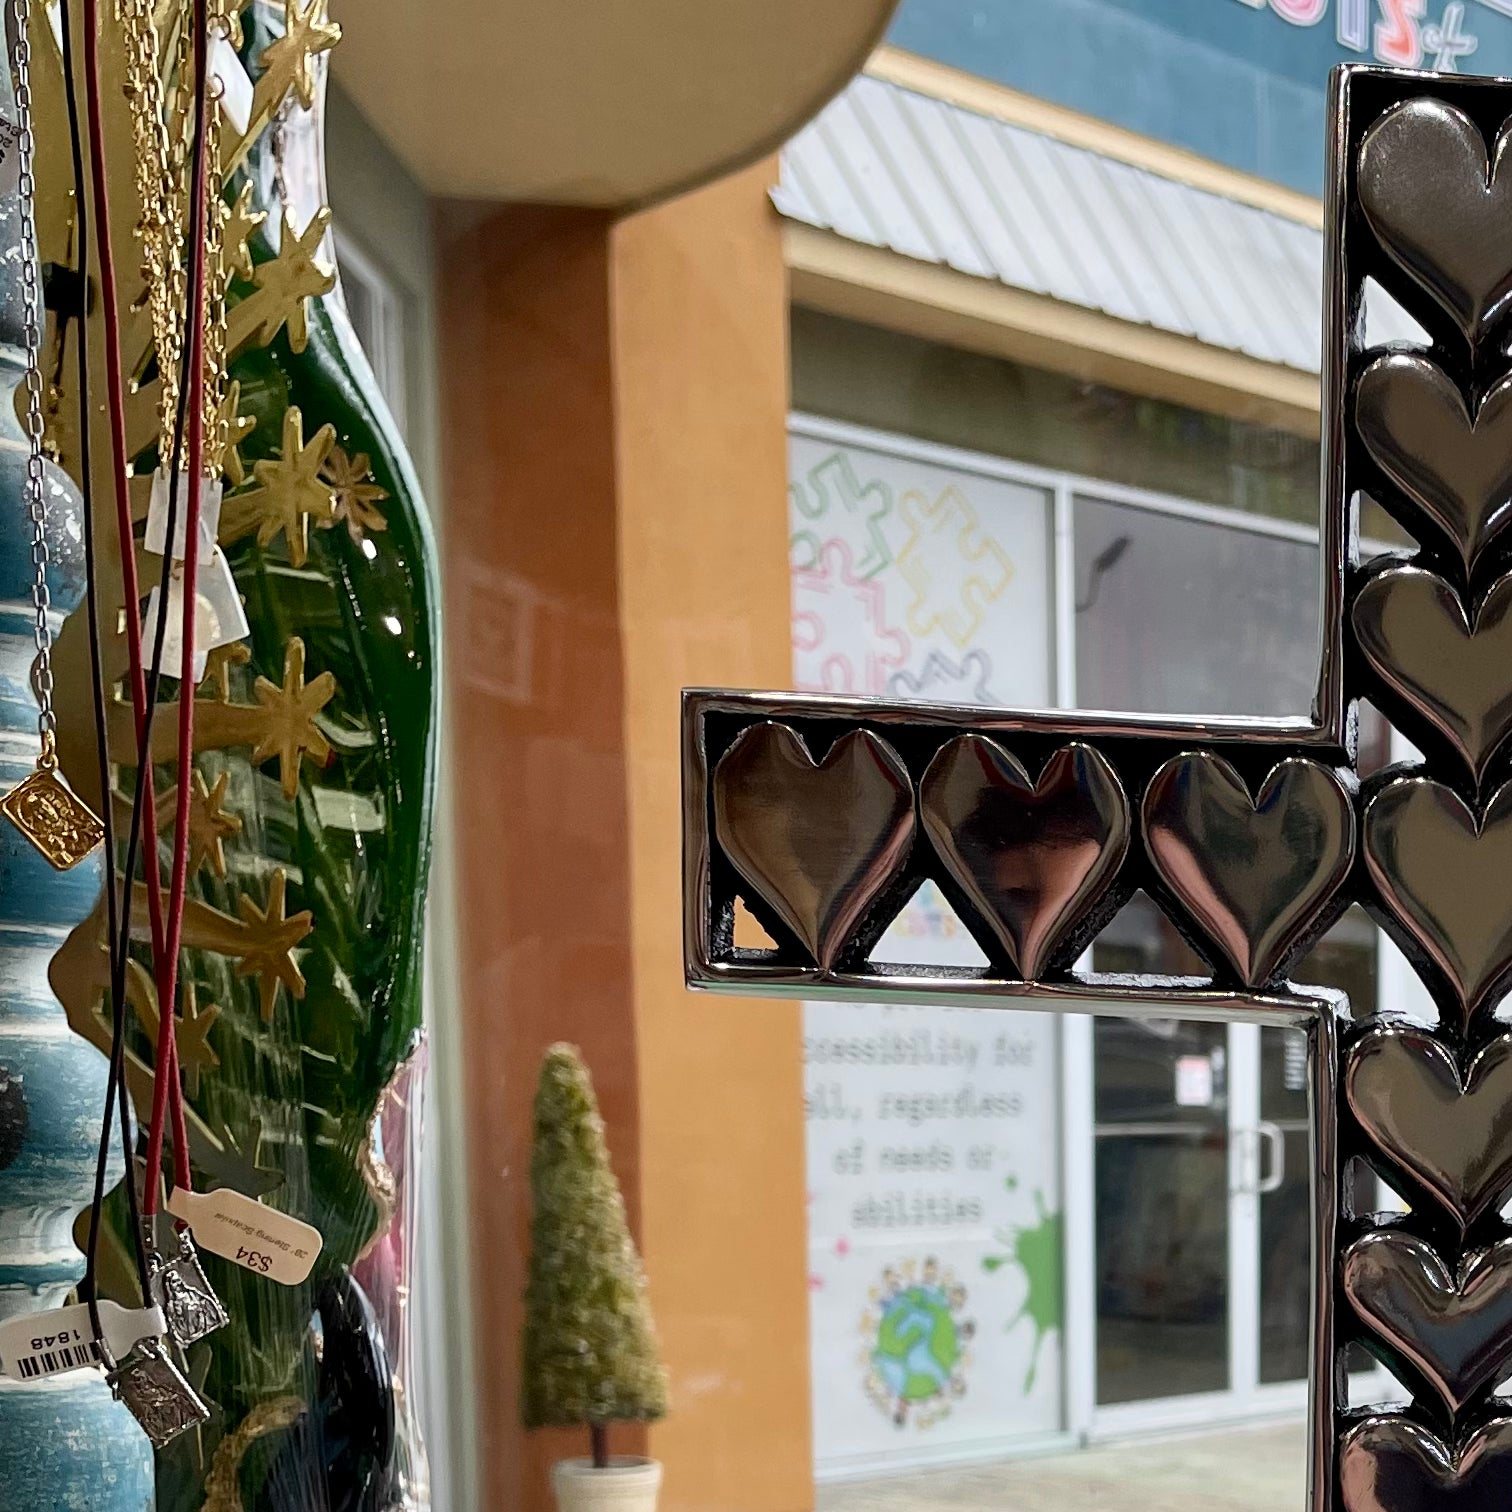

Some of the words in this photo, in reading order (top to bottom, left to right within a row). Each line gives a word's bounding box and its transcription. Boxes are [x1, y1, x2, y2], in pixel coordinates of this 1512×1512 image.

[878, 1083, 1023, 1127] regardless
[879, 1139, 953, 1173] needs
[851, 1190, 984, 1229] abilities
[235, 1246, 273, 1272] $34
[31, 1329, 81, 1350] 1848
